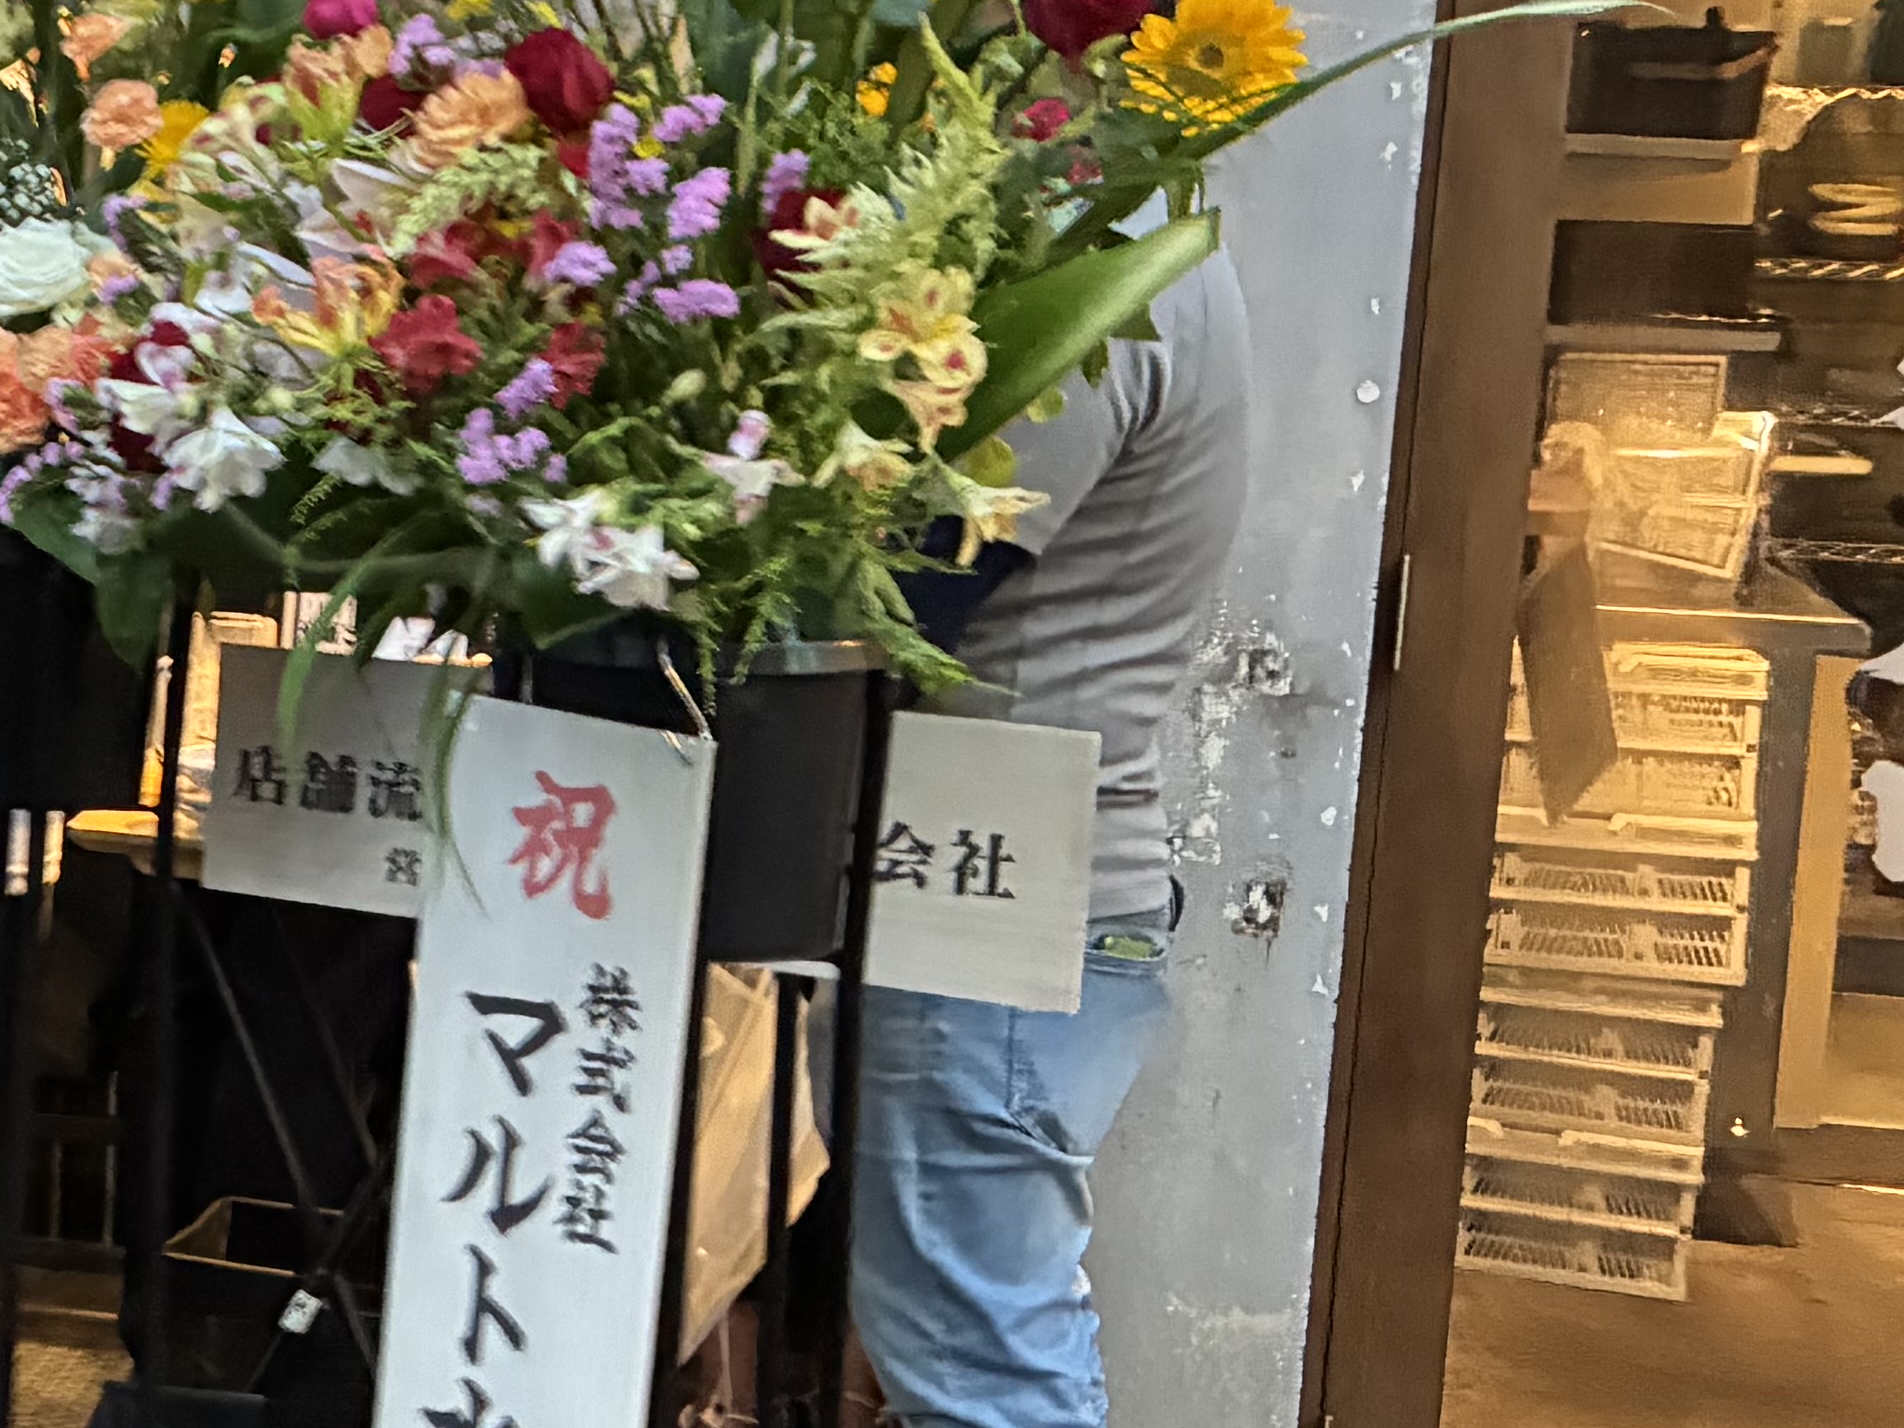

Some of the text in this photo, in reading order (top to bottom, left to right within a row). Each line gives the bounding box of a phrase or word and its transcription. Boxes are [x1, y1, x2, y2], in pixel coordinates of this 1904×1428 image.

[506, 770, 616, 922] 祝
[872, 818, 1020, 902] 会社
[560, 960, 642, 1256] 株式会社
